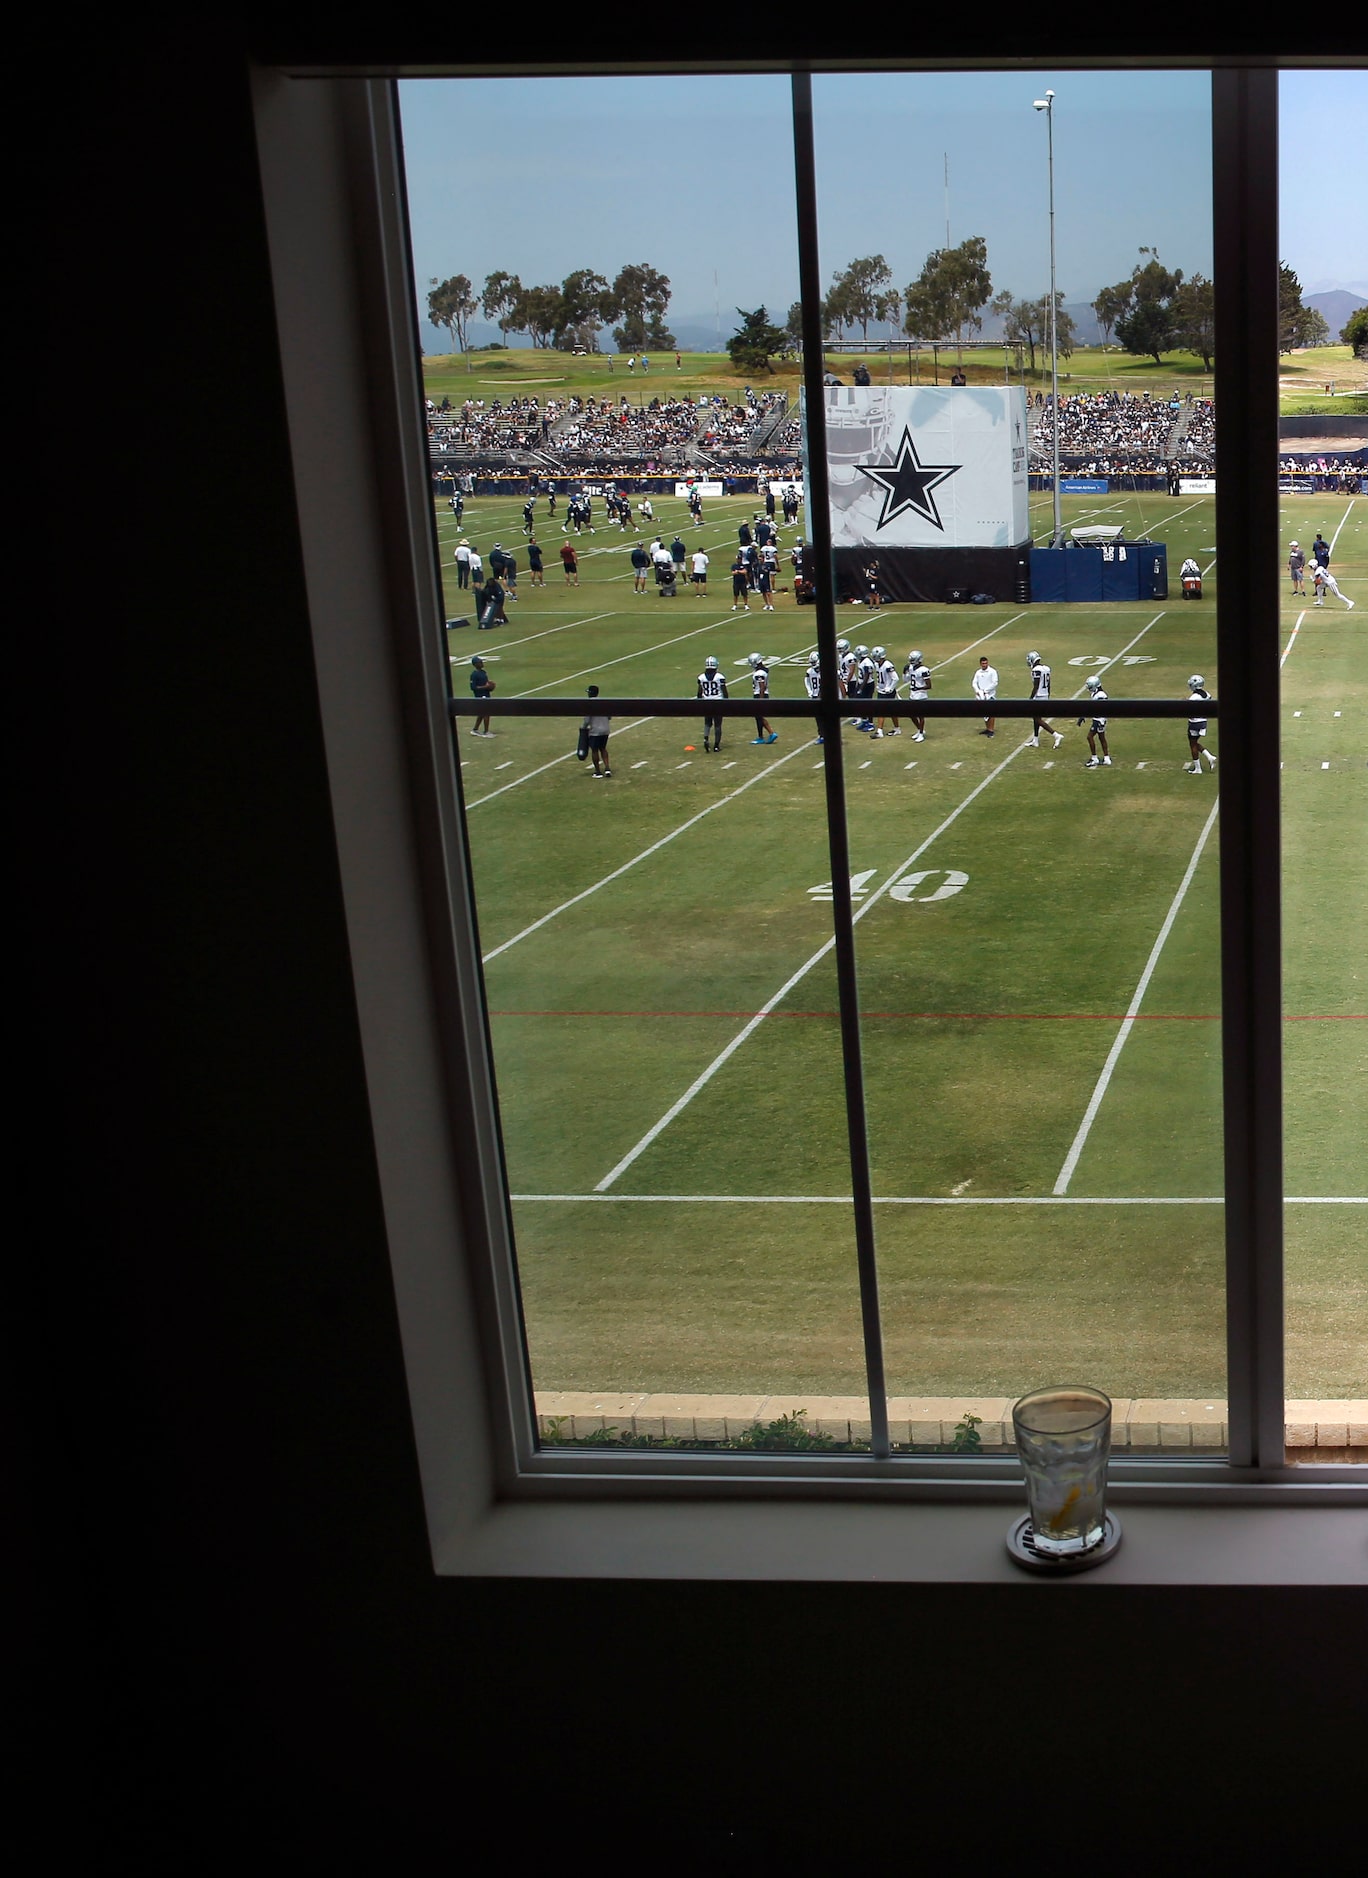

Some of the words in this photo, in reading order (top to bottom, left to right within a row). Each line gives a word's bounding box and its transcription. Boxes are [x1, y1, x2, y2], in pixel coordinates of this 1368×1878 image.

[1067, 655, 1159, 666] 40
[702, 681, 719, 697] 88
[805, 868, 970, 903] 40
